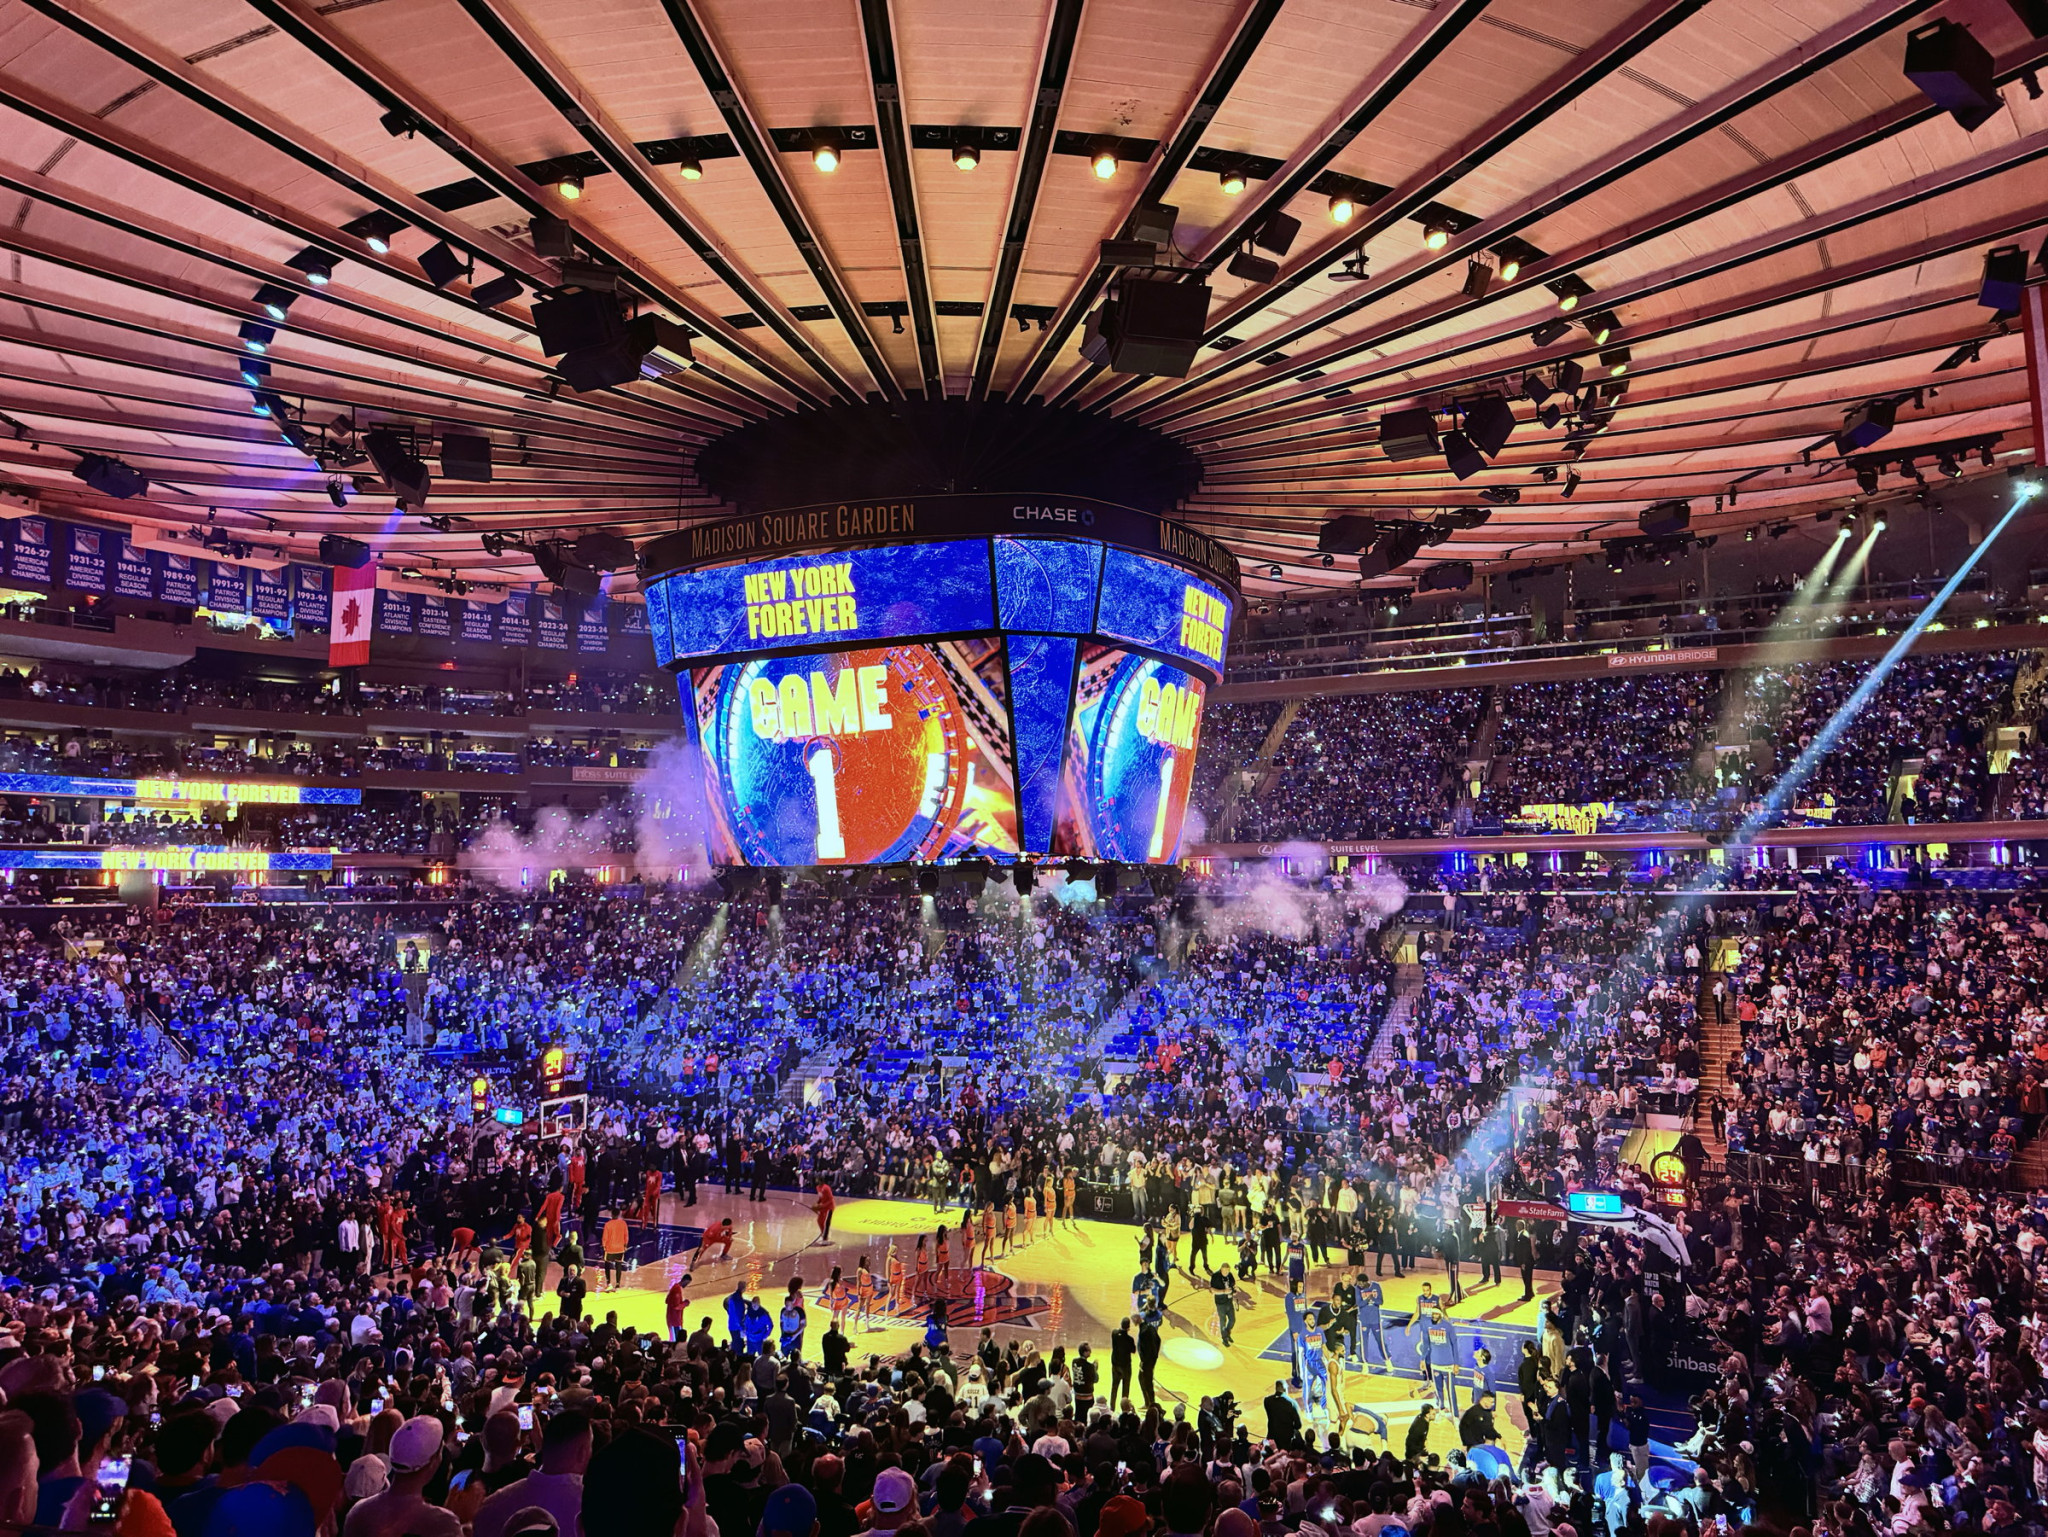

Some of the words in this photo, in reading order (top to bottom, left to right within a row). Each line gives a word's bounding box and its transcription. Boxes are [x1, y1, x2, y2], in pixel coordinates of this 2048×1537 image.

[1013, 507, 1077, 522] CHASE
[691, 520, 756, 559] MADISON
[762, 511, 829, 546] SQUARE
[836, 504, 915, 537] GARDEN
[1160, 520, 1207, 566] MADISON
[14, 544, 51, 558] 1926-27
[69, 554, 105, 568] 1931-32
[17, 563, 46, 574] DIVISION
[117, 562, 152, 575] 1941-42
[11, 569, 51, 582] CHAMPIONS
[72, 572, 100, 582] DIVISION
[118, 573, 150, 583] REGULAR
[162, 570, 197, 583] 1989-90
[66, 579, 106, 591] CHAMPIONS
[120, 580, 147, 590] SEASON
[166, 581, 192, 590] PATRICK
[211, 578, 245, 591] 1991-92
[744, 570, 786, 604] NEW
[789, 563, 856, 597] YORK
[114, 586, 153, 598] CHAMPIONS
[165, 588, 192, 597] DIVISION
[215, 588, 240, 598] PATRICK
[255, 585, 288, 597] 1991-92
[160, 594, 197, 605] CHAMPIONS
[214, 595, 241, 604] DIVISION
[257, 595, 285, 604] REGULAR
[296, 591, 328, 603] 1993-94
[1184, 584, 1208, 619] NEW
[209, 601, 245, 612] CHAMPIONS
[258, 602, 283, 610] SEASON
[298, 601, 326, 610] ATLANTIC
[383, 603, 411, 613] 2011-12
[253, 608, 288, 618] CHAMPIONS
[299, 608, 324, 616] DIVISION
[421, 608, 449, 617] 2013-14
[462, 612, 492, 621] 2014-15
[747, 595, 858, 640] FOREVER
[295, 613, 328, 623] CHAMPIONS
[501, 617, 530, 626] 2014-15
[380, 623, 412, 633] CHAMPIONS
[538, 621, 569, 631] 2023-24
[578, 625, 608, 633] 2023-24
[461, 633, 492, 641] CHAMPIONS
[1629, 653, 1676, 664] HYUNDAI
[1678, 650, 1716, 660] BRIDGE
[749, 664, 893, 739] GAME
[136, 779, 174, 799] NEW
[178, 781, 224, 801] YORK
[227, 784, 300, 803] FOREVER
[808, 748, 846, 859] 1
[1149, 757, 1175, 859] 1
[1330, 845, 1354, 853] SUITE
[1356, 844, 1380, 852] LEVEL
[102, 852, 140, 869] NEW
[142, 852, 193, 869] YORK
[196, 852, 269, 870] FOREVER
[482, 1067, 512, 1075] ULTRA
[1529, 1206, 1547, 1216] State
[1547, 1208, 1565, 1218] Farm
[1667, 1356, 1725, 1374] oinbase
